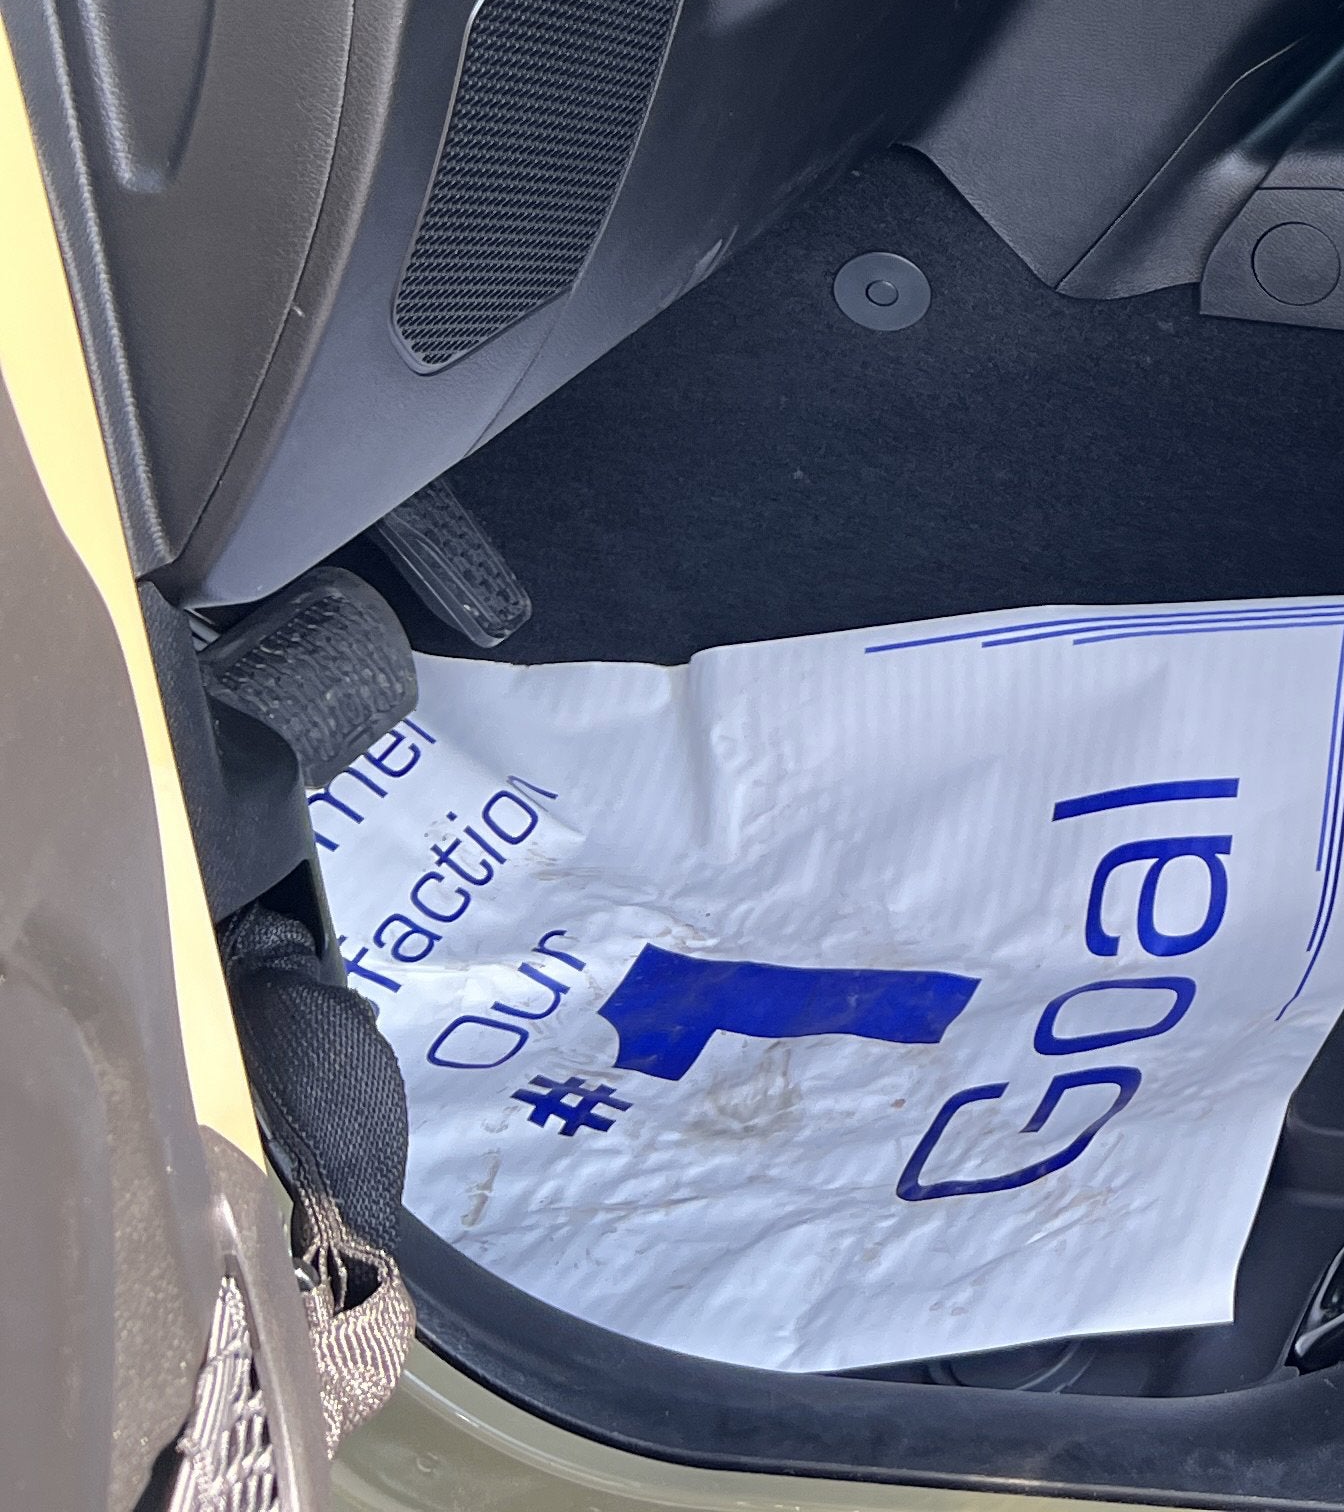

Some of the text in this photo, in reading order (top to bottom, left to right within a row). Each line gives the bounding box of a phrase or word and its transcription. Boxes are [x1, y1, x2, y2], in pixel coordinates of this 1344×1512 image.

[344, 775, 558, 993] faction
[896, 778, 1239, 1202] Goal
[427, 930, 586, 1069] Our
